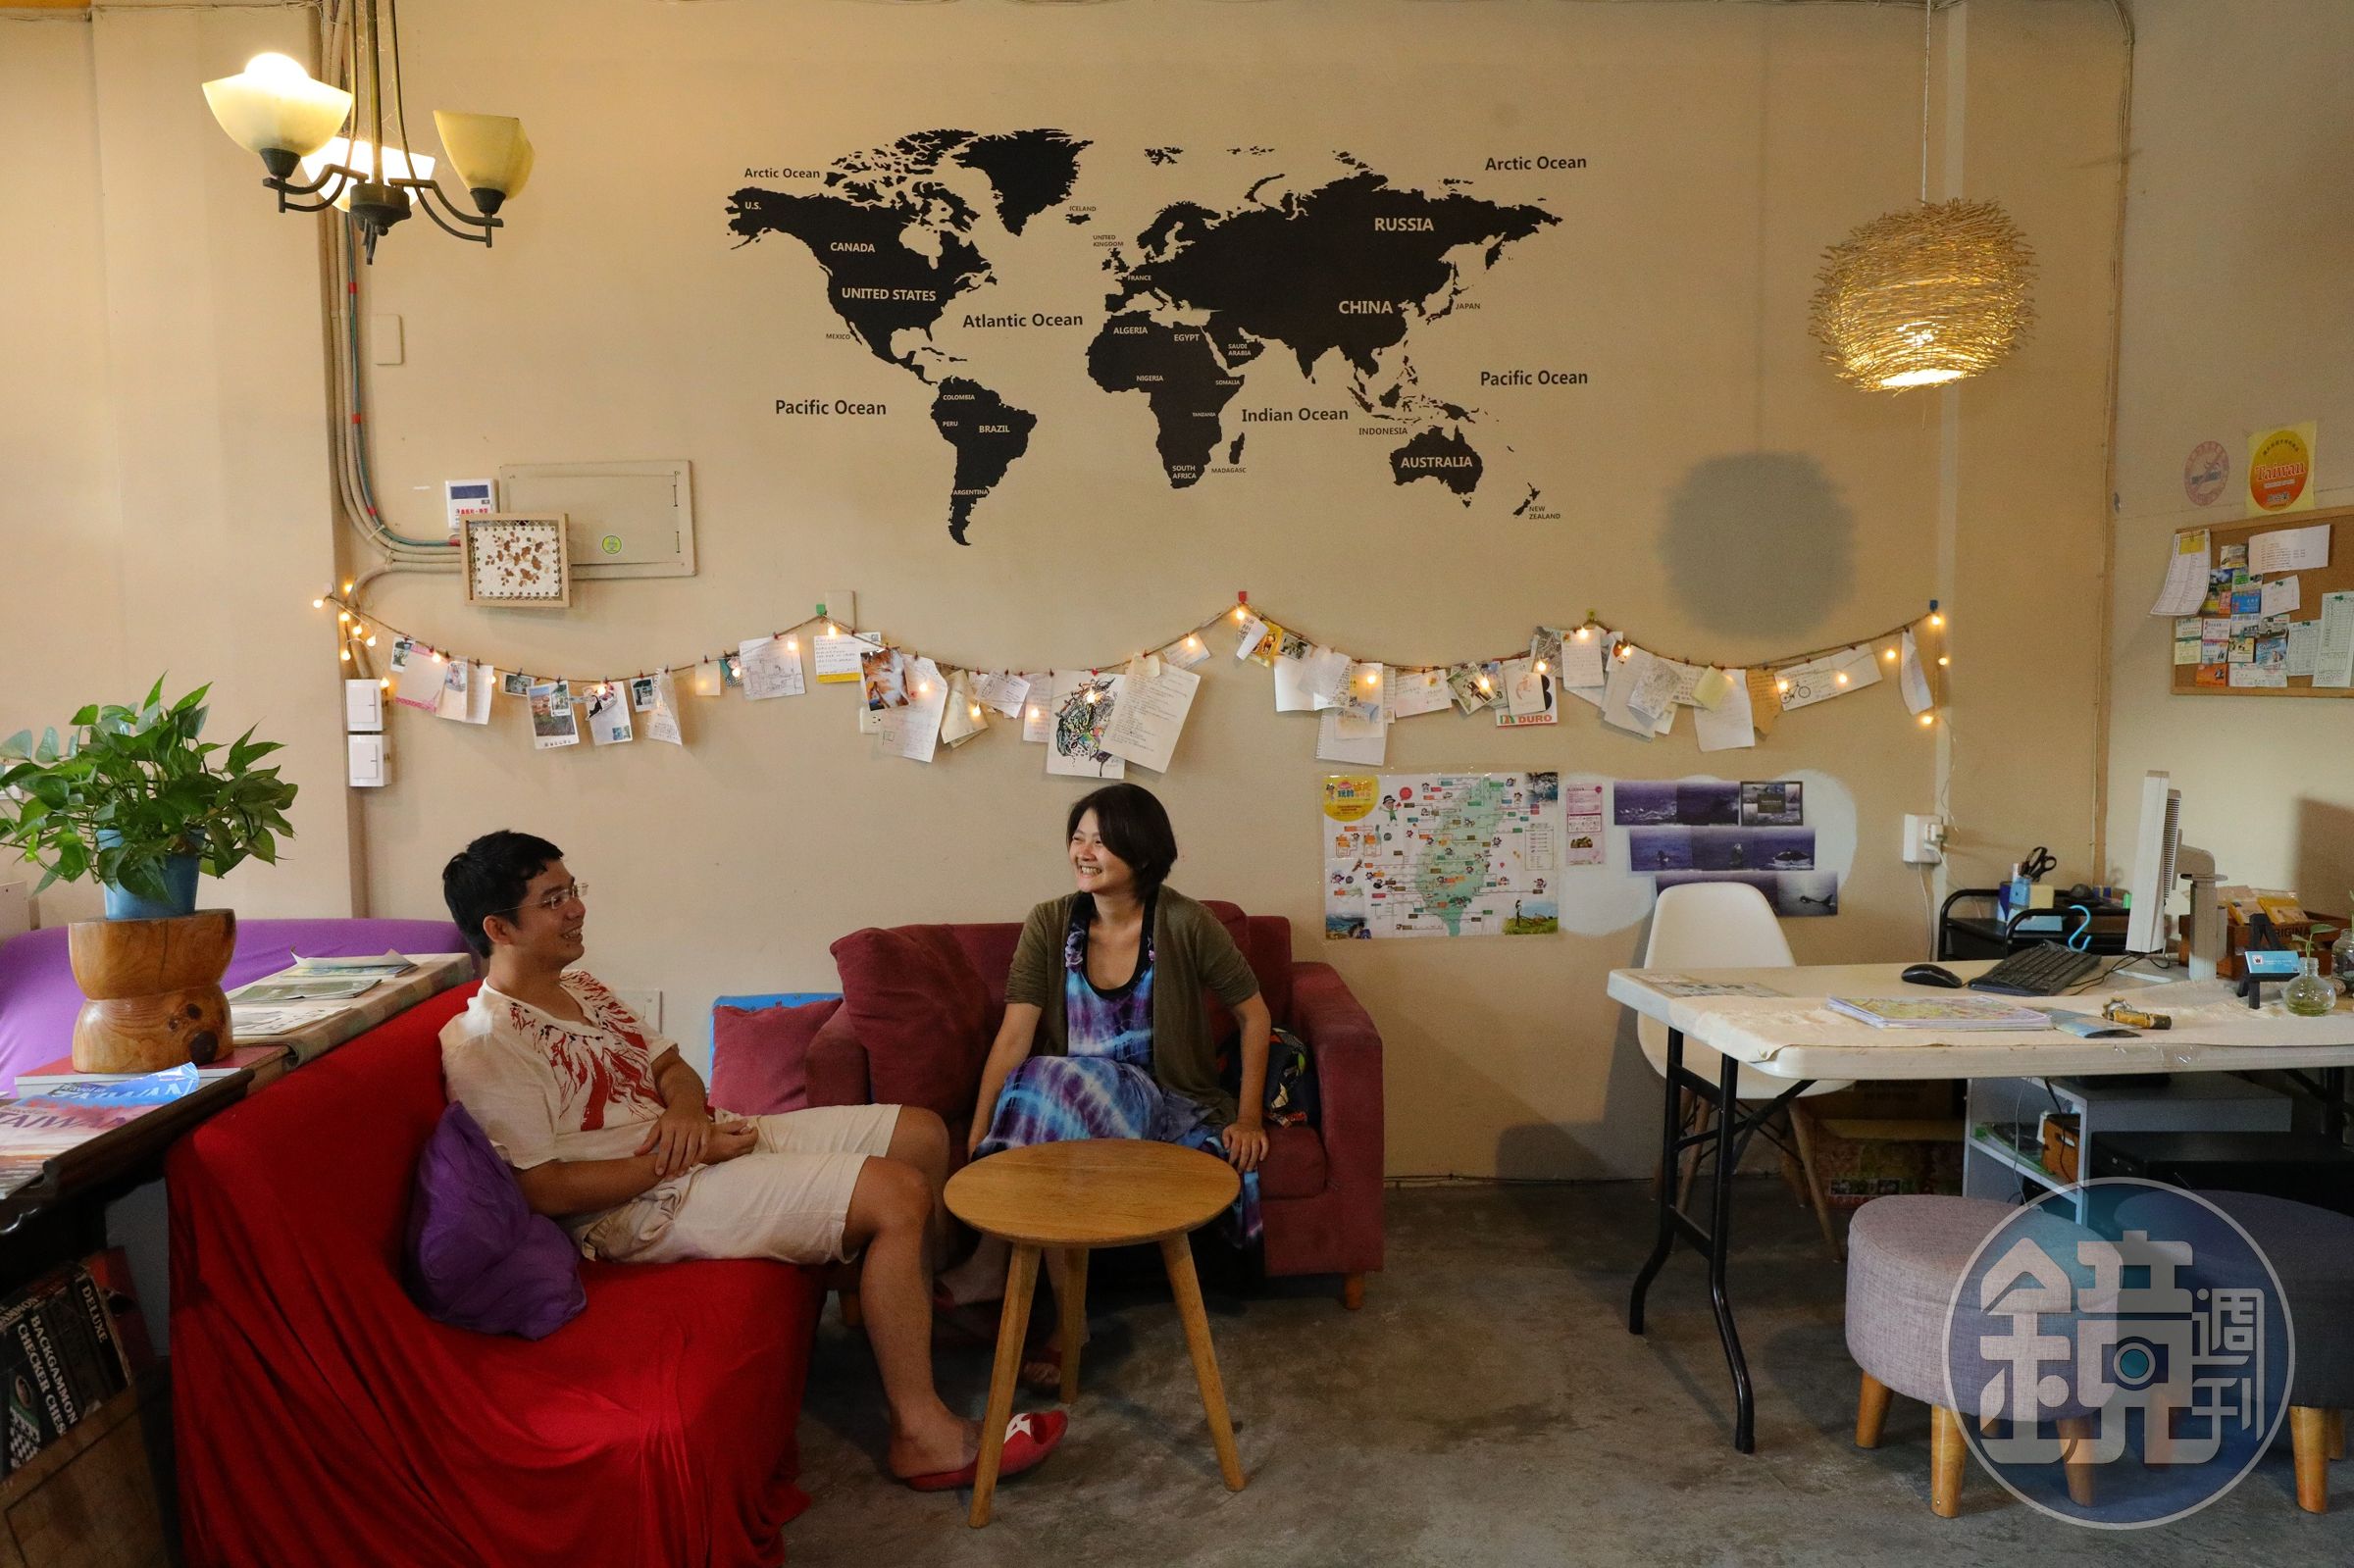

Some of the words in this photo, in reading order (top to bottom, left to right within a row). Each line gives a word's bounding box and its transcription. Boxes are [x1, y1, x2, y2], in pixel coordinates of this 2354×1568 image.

[1485, 156, 1532, 172] Arctic
[1537, 155, 1587, 170] Ocean
[743, 167, 780, 179] Arctic
[782, 167, 821, 179] Ocean
[744, 201, 762, 211] U.S.
[1374, 217, 1434, 231] RUSSIA
[830, 241, 876, 254] CANADA
[842, 287, 890, 301] UNITED
[892, 288, 937, 303] STATES
[1339, 300, 1394, 315] CHINA
[1456, 302, 1481, 311] JAPAN
[963, 312, 1026, 329] Atlantic
[1032, 312, 1084, 329] Ocean
[826, 332, 851, 341] MEXICO
[1113, 326, 1149, 335] ALGERIA
[1173, 333, 1200, 343] EGYPT
[1480, 370, 1533, 386] Pacific
[1538, 370, 1588, 385] Ocean
[775, 399, 829, 416] Pacific
[835, 400, 887, 416] Ocean
[1242, 408, 1293, 423] Indian
[1298, 407, 1349, 422] Ocean
[979, 425, 1010, 433] BRAZIL
[1358, 427, 1408, 436] INDONESIA
[1401, 456, 1473, 469] AUSTRALIA
[2255, 462, 2307, 481] Taiwan
[1518, 715, 1553, 724] DURO
[81, 1285, 107, 1344] DELUXE
[30, 1314, 78, 1426] BACKGAMMON
[18, 1324, 50, 1393] CHECKER
[46, 1393, 67, 1437] CHES
